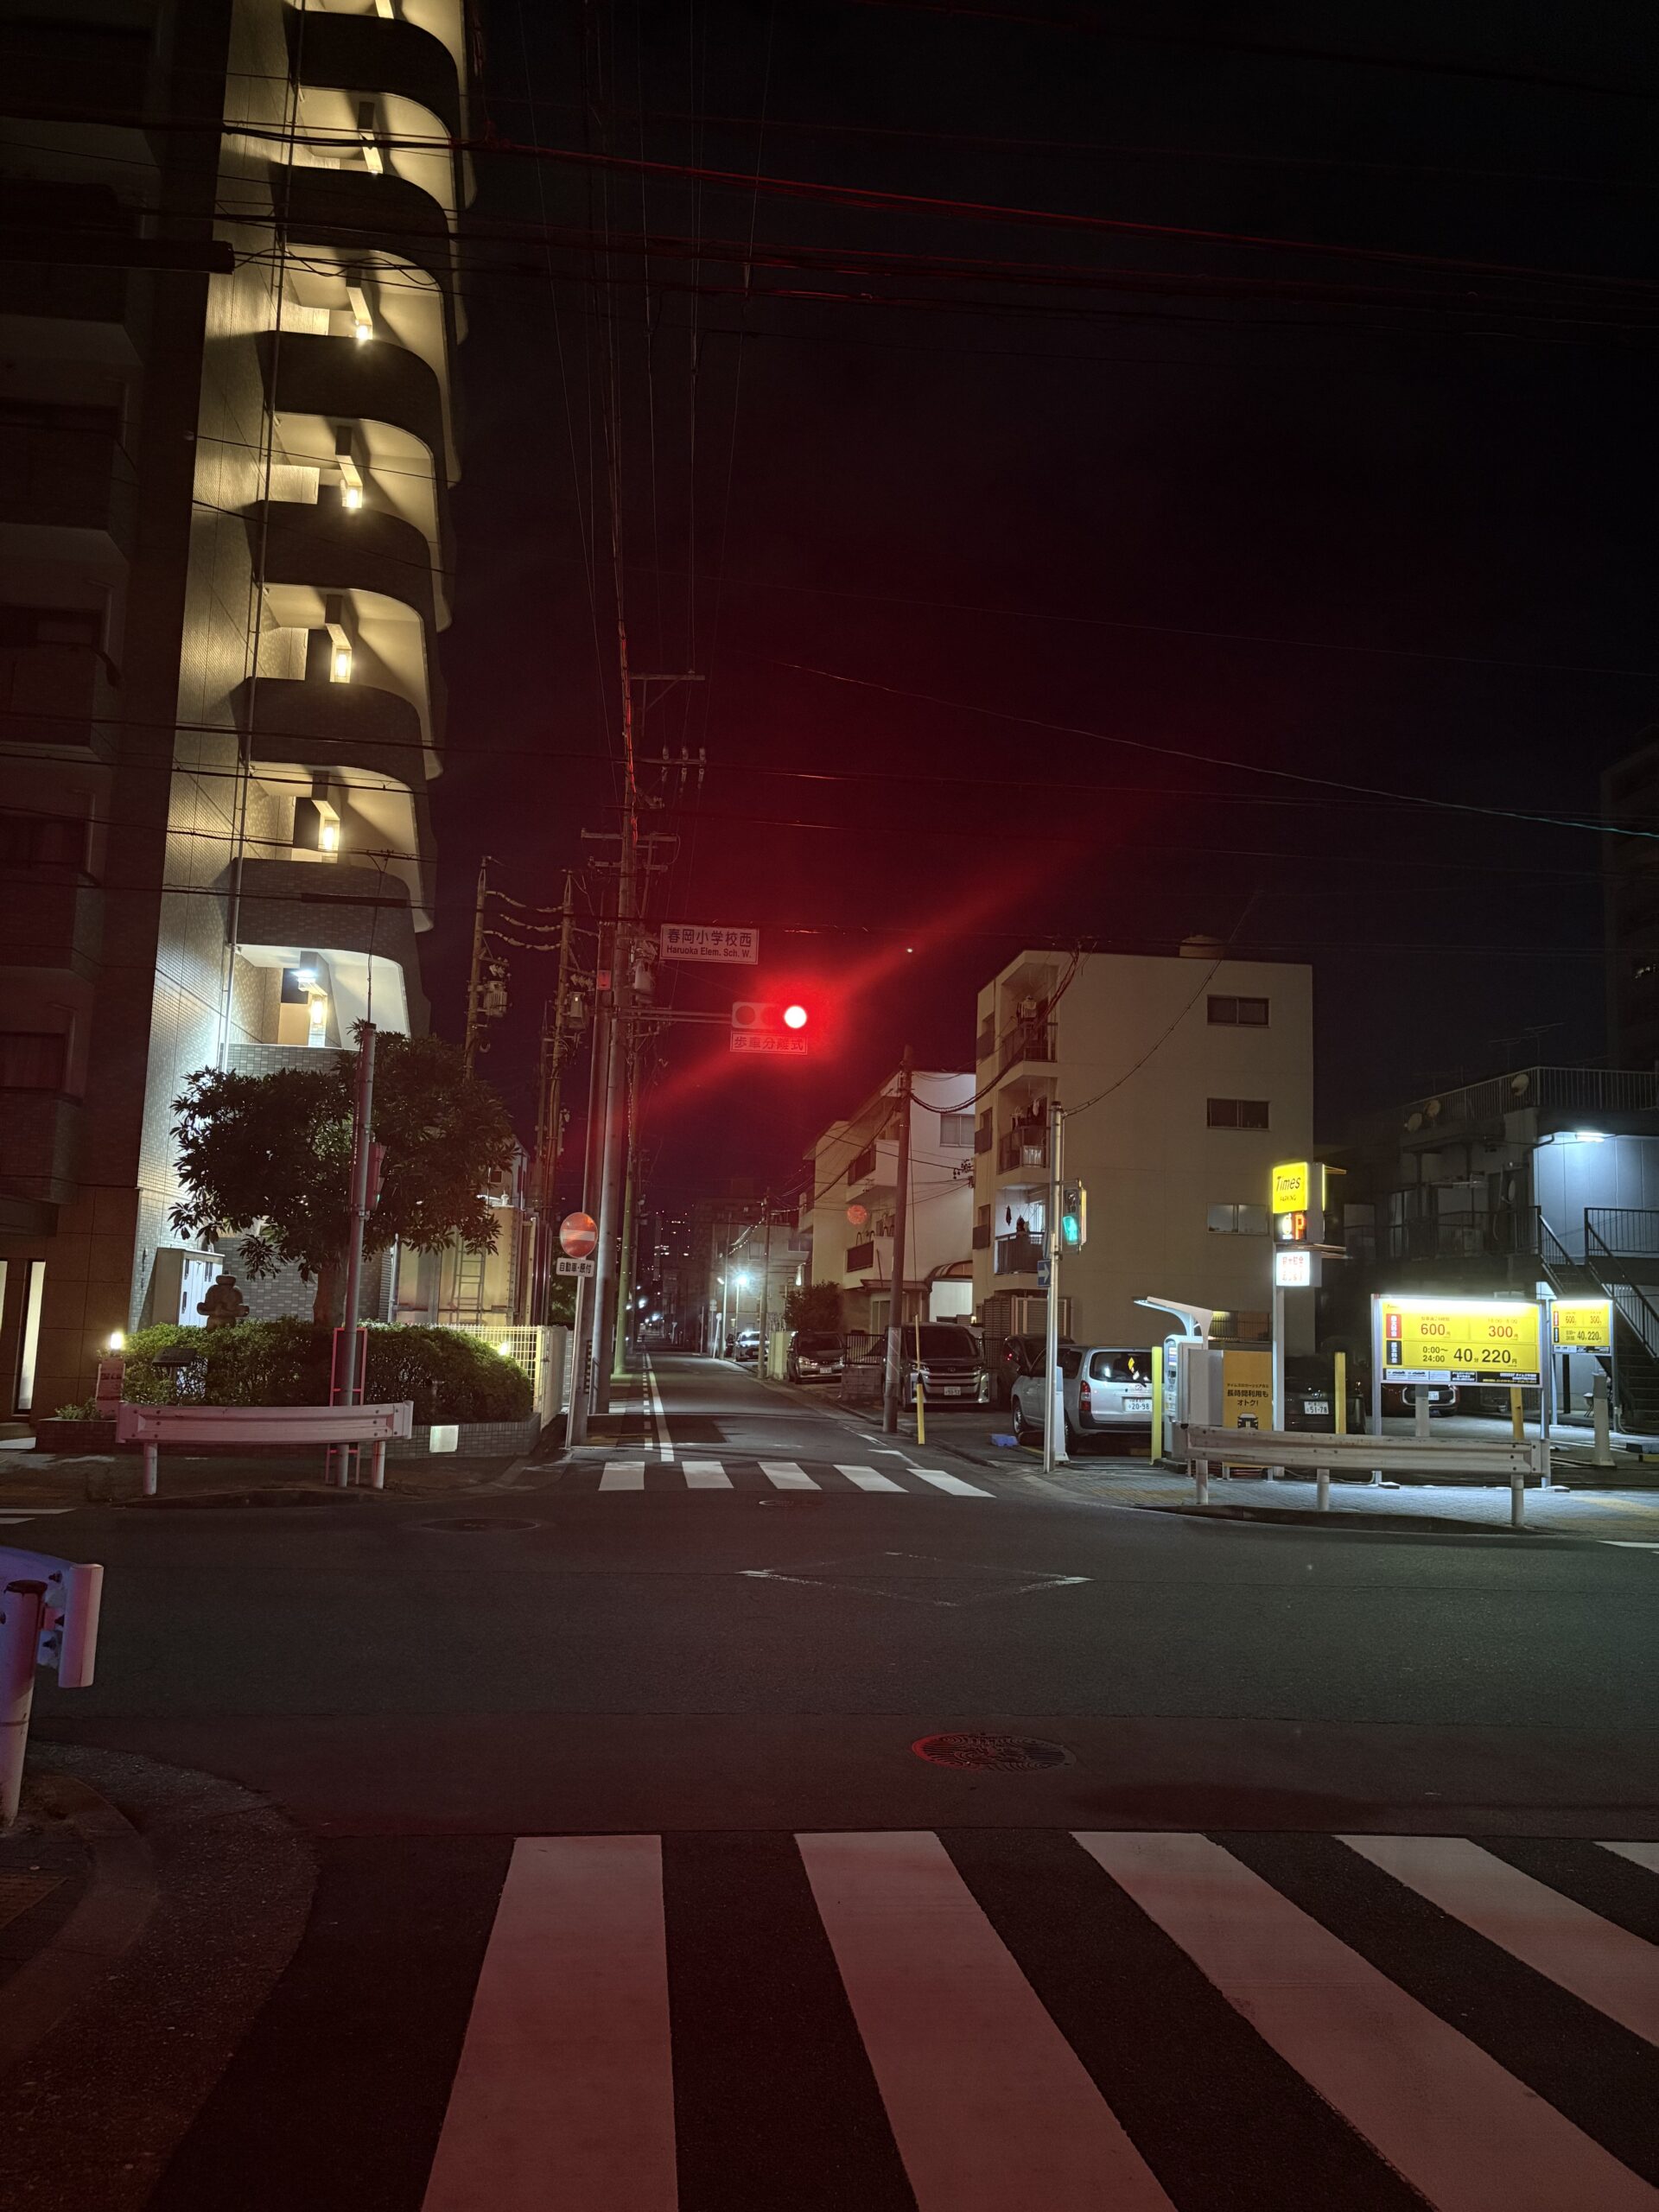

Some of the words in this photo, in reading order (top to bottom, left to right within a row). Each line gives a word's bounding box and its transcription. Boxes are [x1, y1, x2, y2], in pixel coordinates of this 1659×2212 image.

[668, 929, 752, 947] 春岡小学校西
[666, 945, 698, 957] Haruoka
[701, 947, 721, 957] Elem.
[723, 949, 740, 957] Sch.
[742, 950, 752, 958] W.
[734, 1037, 804, 1052] 歩車分離式
[1276, 1175, 1301, 1192] Times
[1227, 1389, 1269, 1398] 長時間利用も
